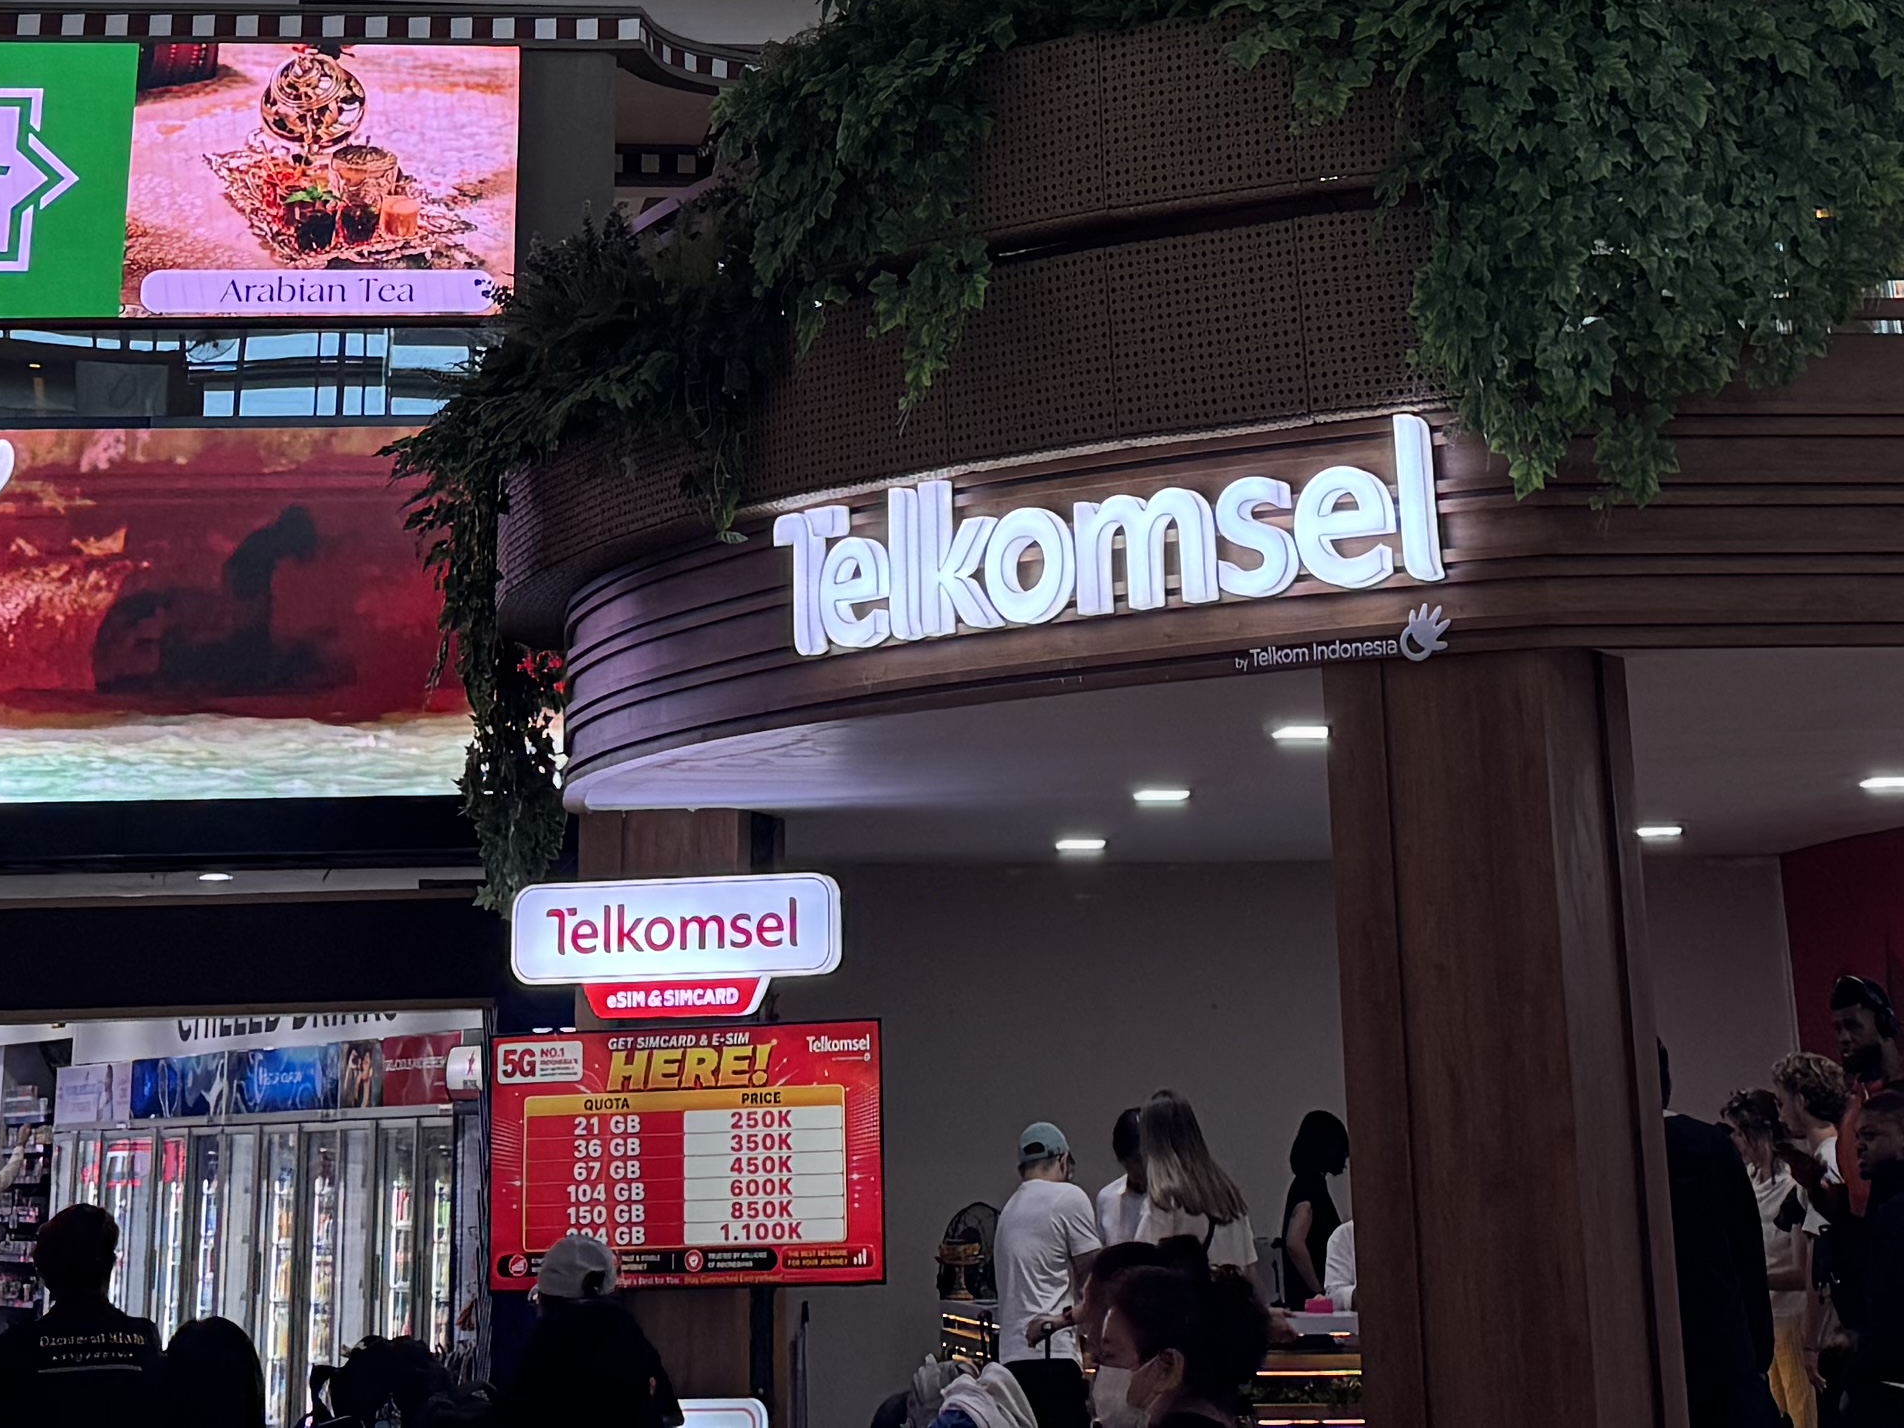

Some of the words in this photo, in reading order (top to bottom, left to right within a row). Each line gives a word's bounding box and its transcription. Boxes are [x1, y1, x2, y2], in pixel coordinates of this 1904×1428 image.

[219, 275, 344, 304] Arabian
[357, 277, 415, 304] Tea
[772, 411, 1448, 658] Telkomsel
[1234, 656, 1249, 672] by
[1249, 646, 1310, 668] Telkom
[1312, 639, 1398, 662] Indonesia
[546, 896, 799, 956] Telkomsel
[606, 989, 646, 1009] eSIM
[647, 989, 663, 1007] &
[663, 986, 739, 1007] SIMCARD
[607, 1037, 634, 1051] GET
[636, 1034, 697, 1050] SIMCARD
[698, 1034, 709, 1048] &
[711, 1031, 750, 1047] E-SIM
[805, 1033, 871, 1053] Telkomsel
[501, 1047, 537, 1079] 5G
[540, 1047, 565, 1058] NO.1
[605, 1038, 779, 1093] HERE!
[583, 1097, 630, 1112] QUOTA
[740, 1091, 782, 1106] PRICE
[573, 1117, 600, 1136] 21
[609, 1115, 641, 1135] GB
[730, 1110, 793, 1129] 250K
[573, 1140, 602, 1158] 36
[609, 1138, 641, 1157] GB
[730, 1132, 793, 1152] 350K
[573, 1162, 601, 1181] 67
[609, 1160, 641, 1180] GB
[730, 1155, 793, 1175] 450K
[566, 1185, 607, 1203] 104
[614, 1182, 645, 1202] GB
[730, 1177, 793, 1197] 600K
[566, 1206, 607, 1225] 150
[614, 1204, 646, 1224] GB
[730, 1199, 793, 1220] 850K
[614, 1225, 646, 1245] GB
[720, 1221, 803, 1242] 1.100K
